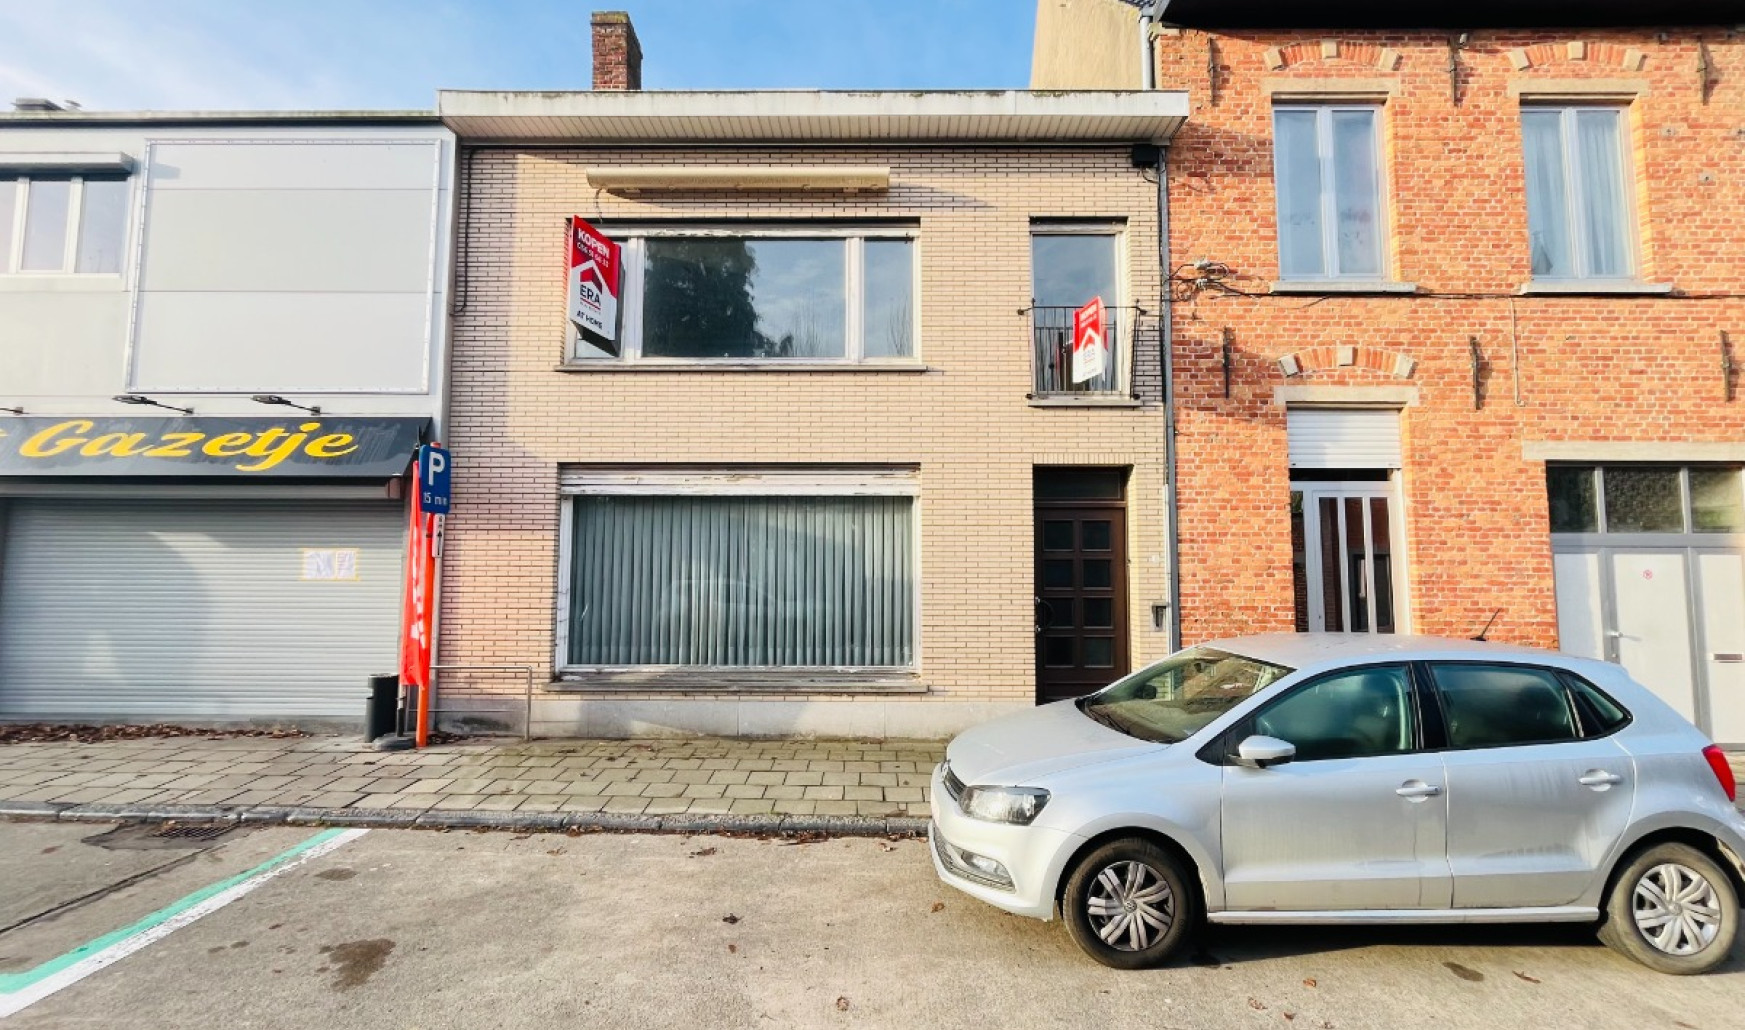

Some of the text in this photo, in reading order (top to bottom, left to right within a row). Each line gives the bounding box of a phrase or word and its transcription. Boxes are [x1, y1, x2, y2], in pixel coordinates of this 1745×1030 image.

[578, 227, 610, 260] KOPEN
[580, 284, 601, 307] ERA
[19, 419, 359, 472] Gazetje
[428, 451, 446, 487] P
[422, 492, 432, 504] 15
